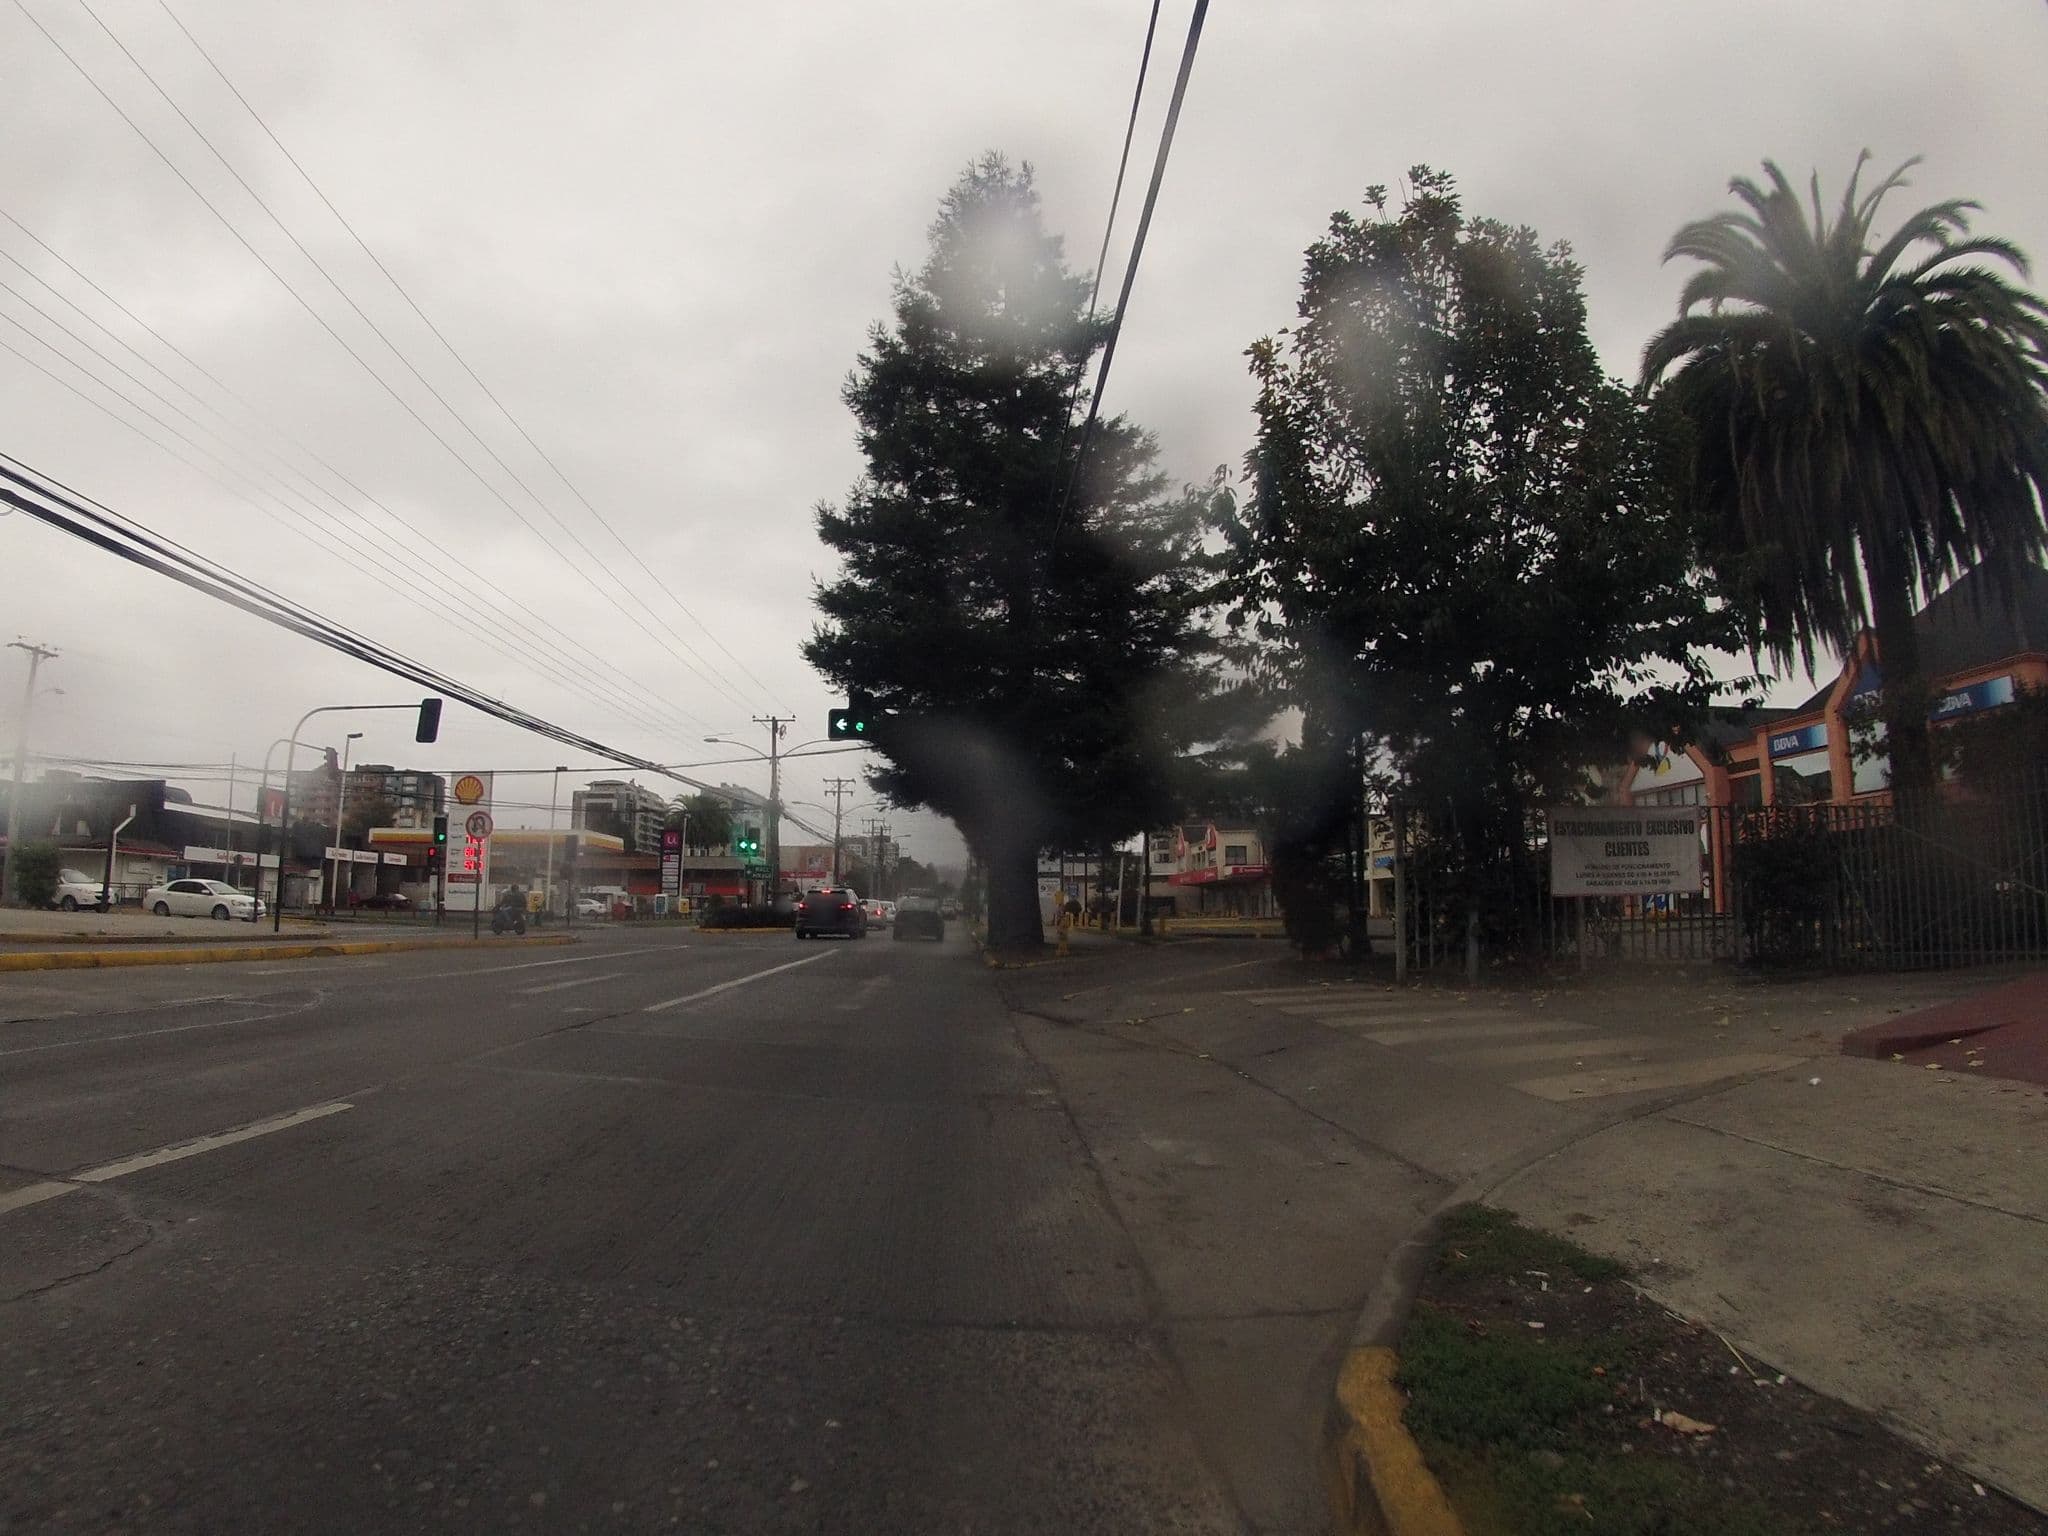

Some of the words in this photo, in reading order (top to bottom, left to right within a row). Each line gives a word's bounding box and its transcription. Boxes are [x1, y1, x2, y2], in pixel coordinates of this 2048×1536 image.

[1773, 735, 1799, 752] BBVA
[1554, 820, 1642, 836] ESTACIONAMIENTO
[1646, 819, 1695, 836] EXCLUSIVO
[1604, 841, 1650, 857] CLIENTES
